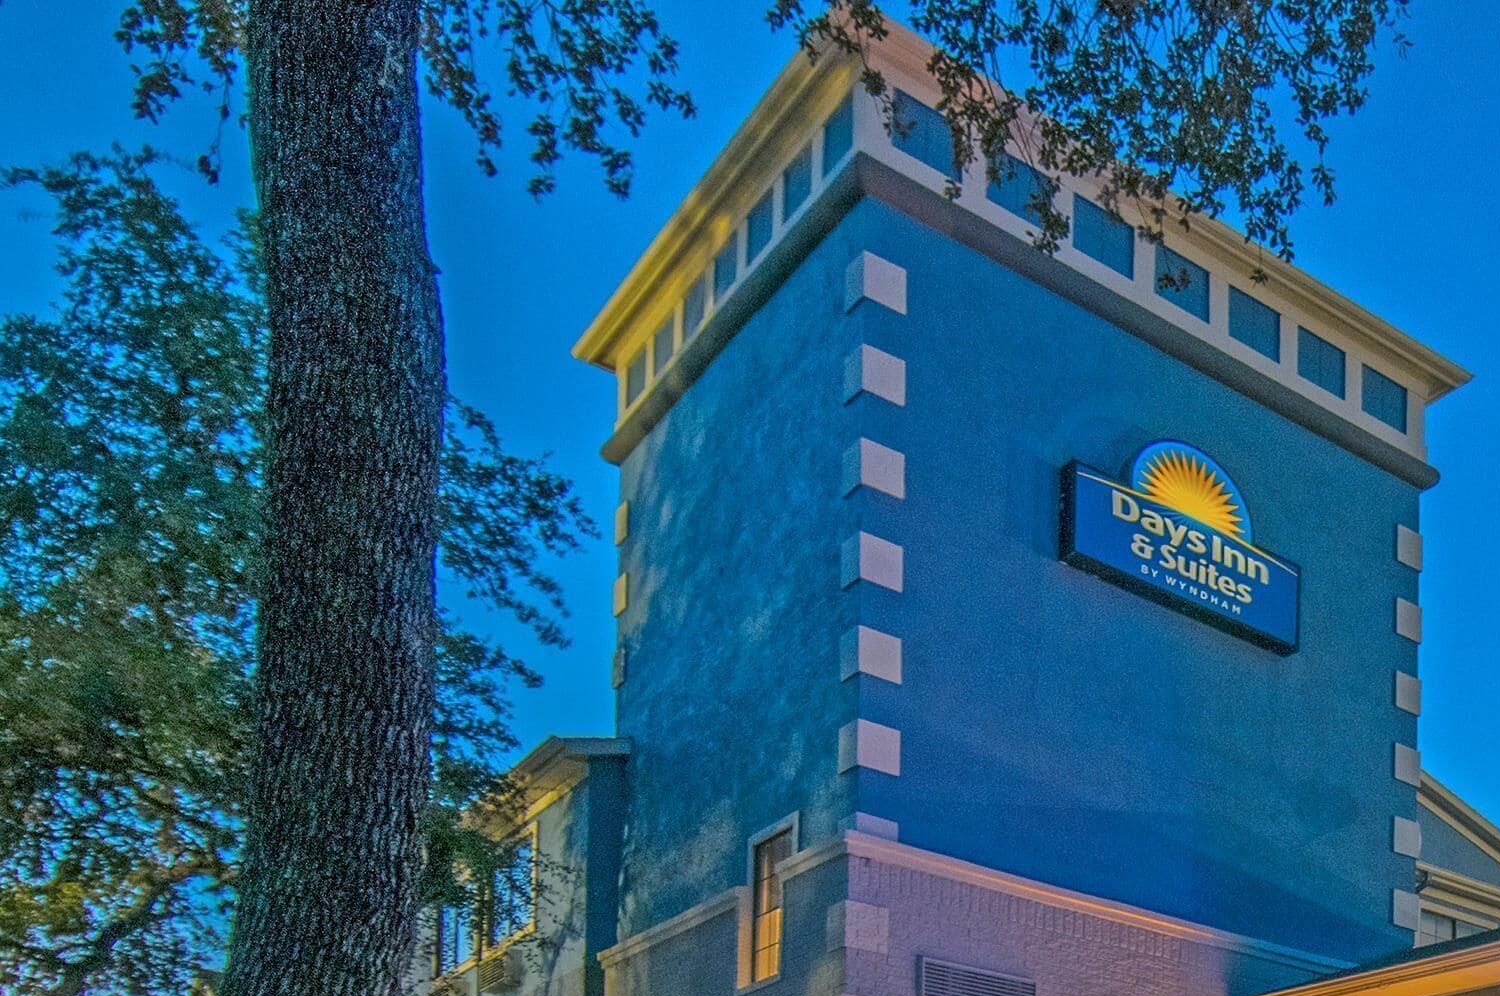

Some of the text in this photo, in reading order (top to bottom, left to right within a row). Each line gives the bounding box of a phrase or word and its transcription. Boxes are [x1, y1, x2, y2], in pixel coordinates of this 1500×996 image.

[1112, 490, 1269, 585] Days Inn
[1131, 533, 1252, 604] & Suites
[1140, 564, 1241, 615] BY WYNDHAM
